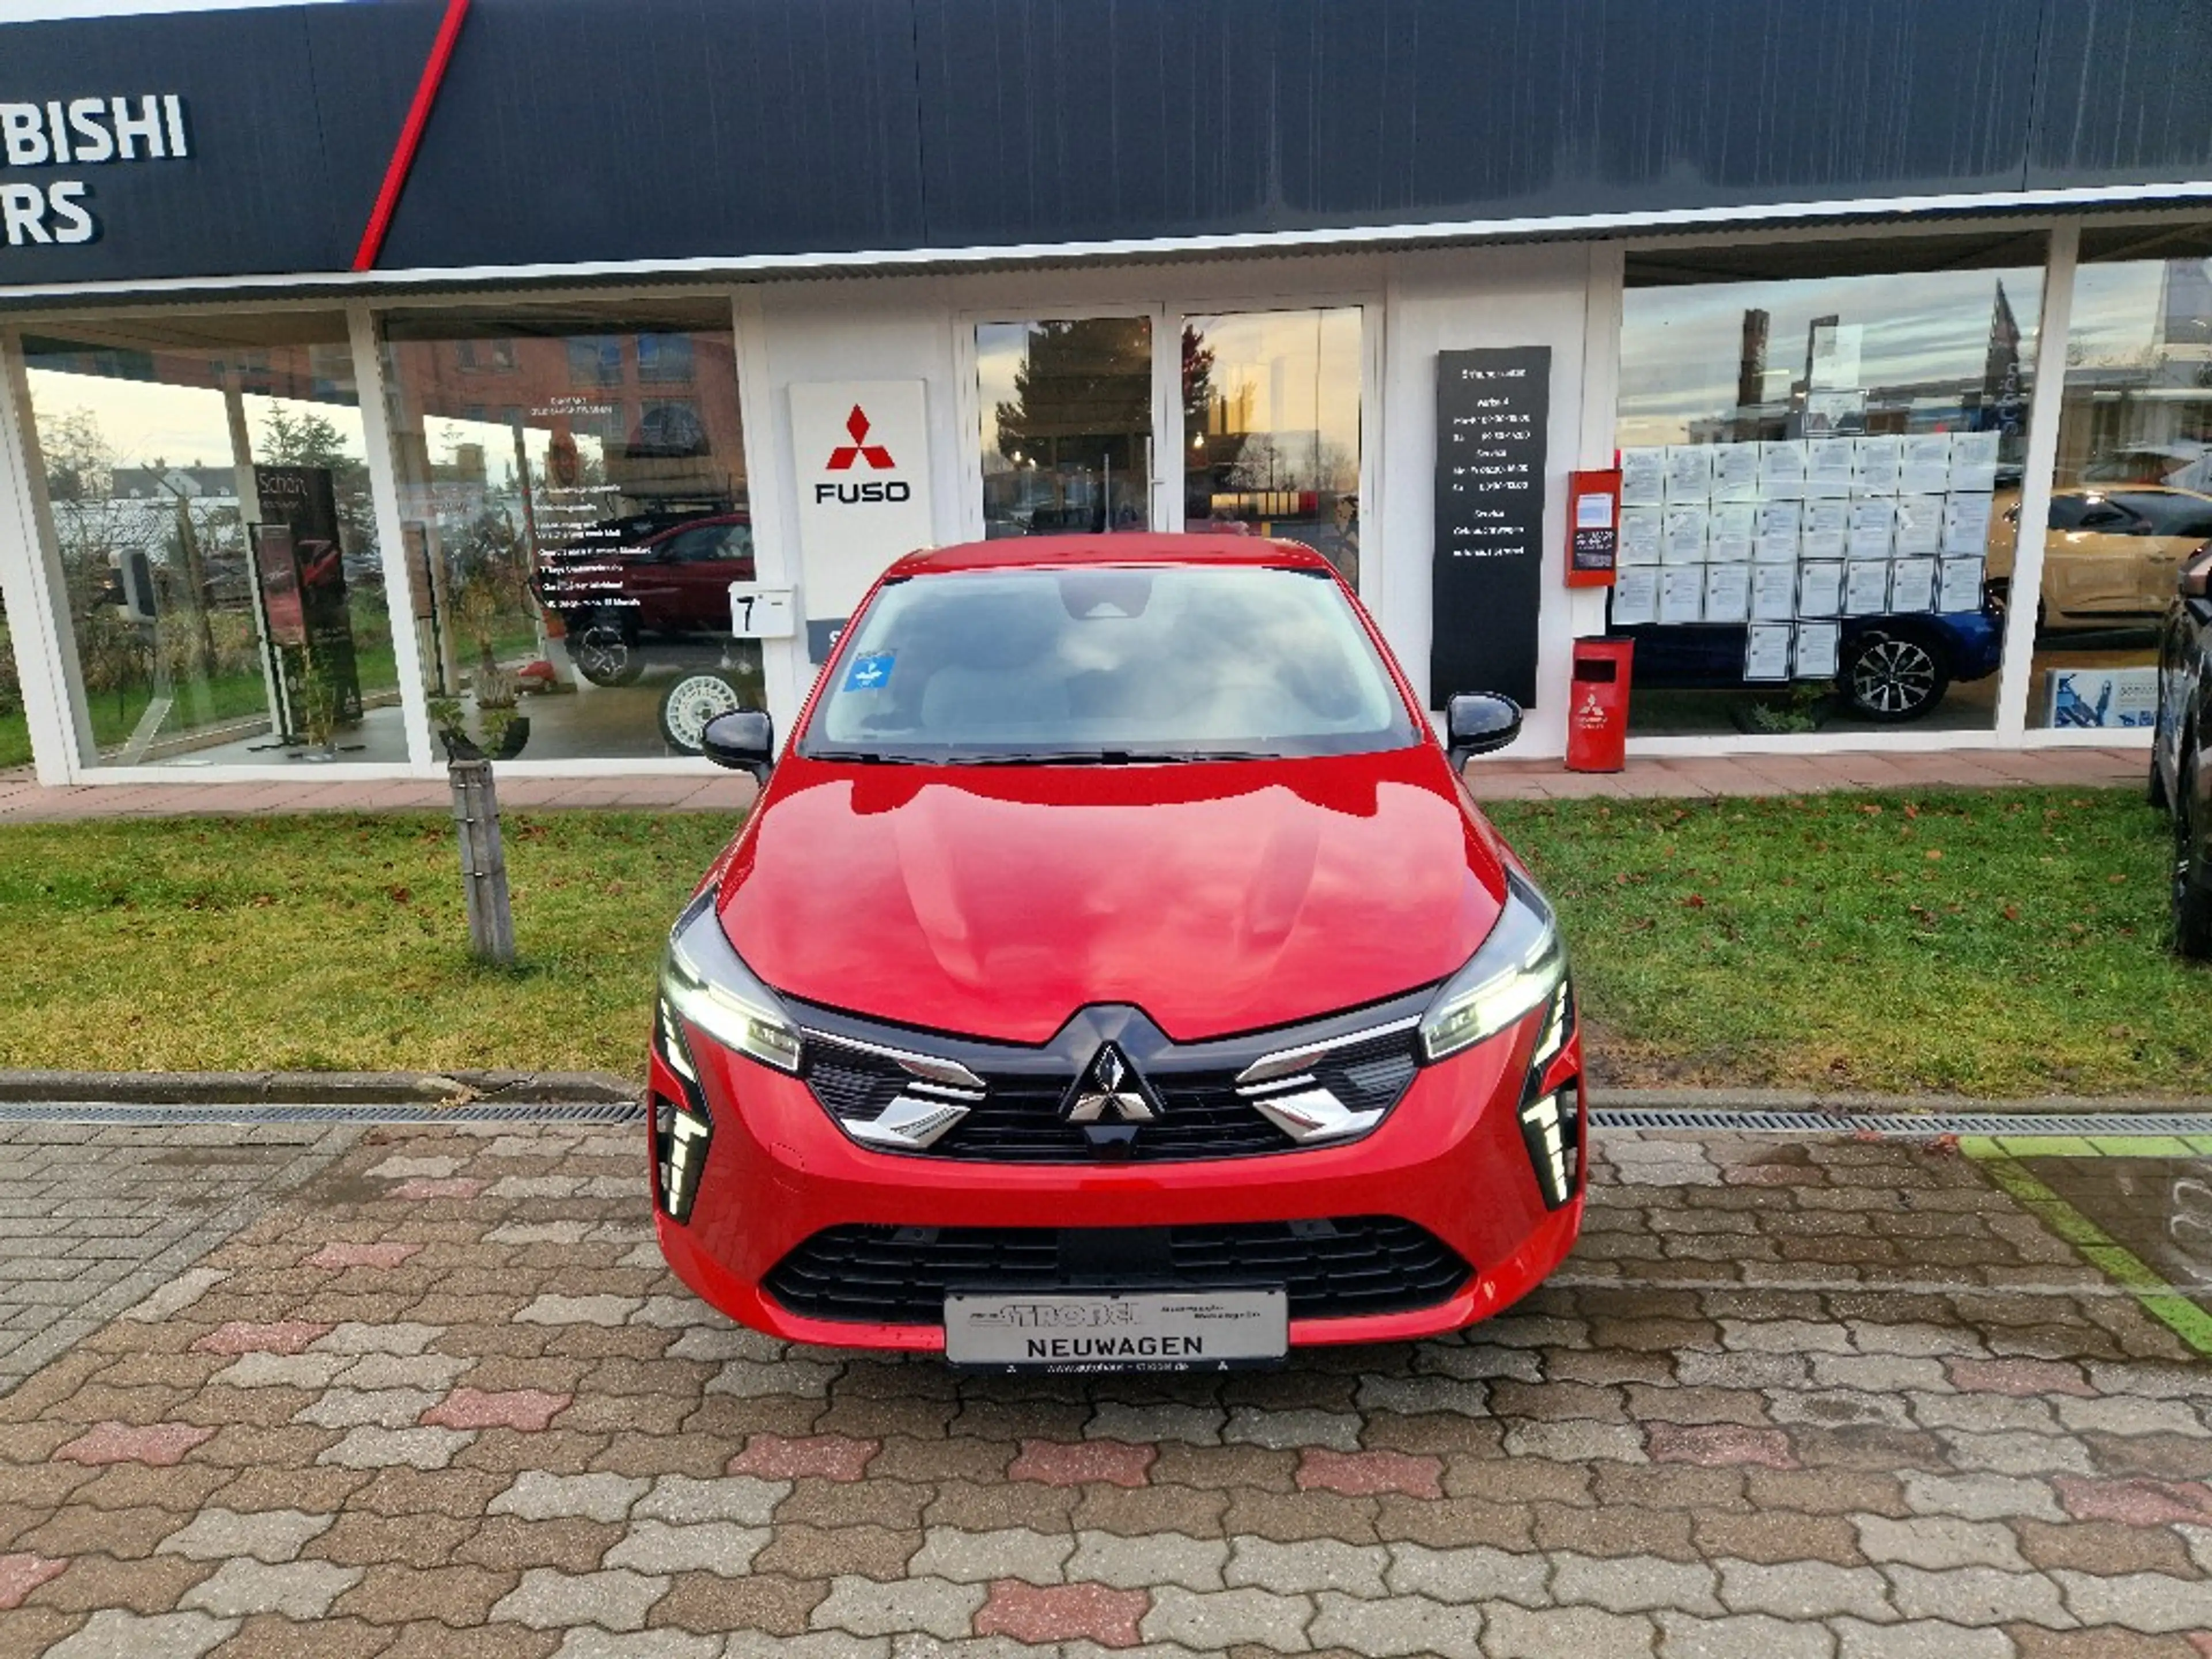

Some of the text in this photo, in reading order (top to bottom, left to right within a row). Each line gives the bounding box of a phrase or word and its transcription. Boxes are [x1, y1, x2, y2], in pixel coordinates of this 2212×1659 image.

[815, 482, 910, 504] FUSO
[737, 596, 755, 631] 7
[1027, 1336, 1203, 1358] NEUWAGEN
